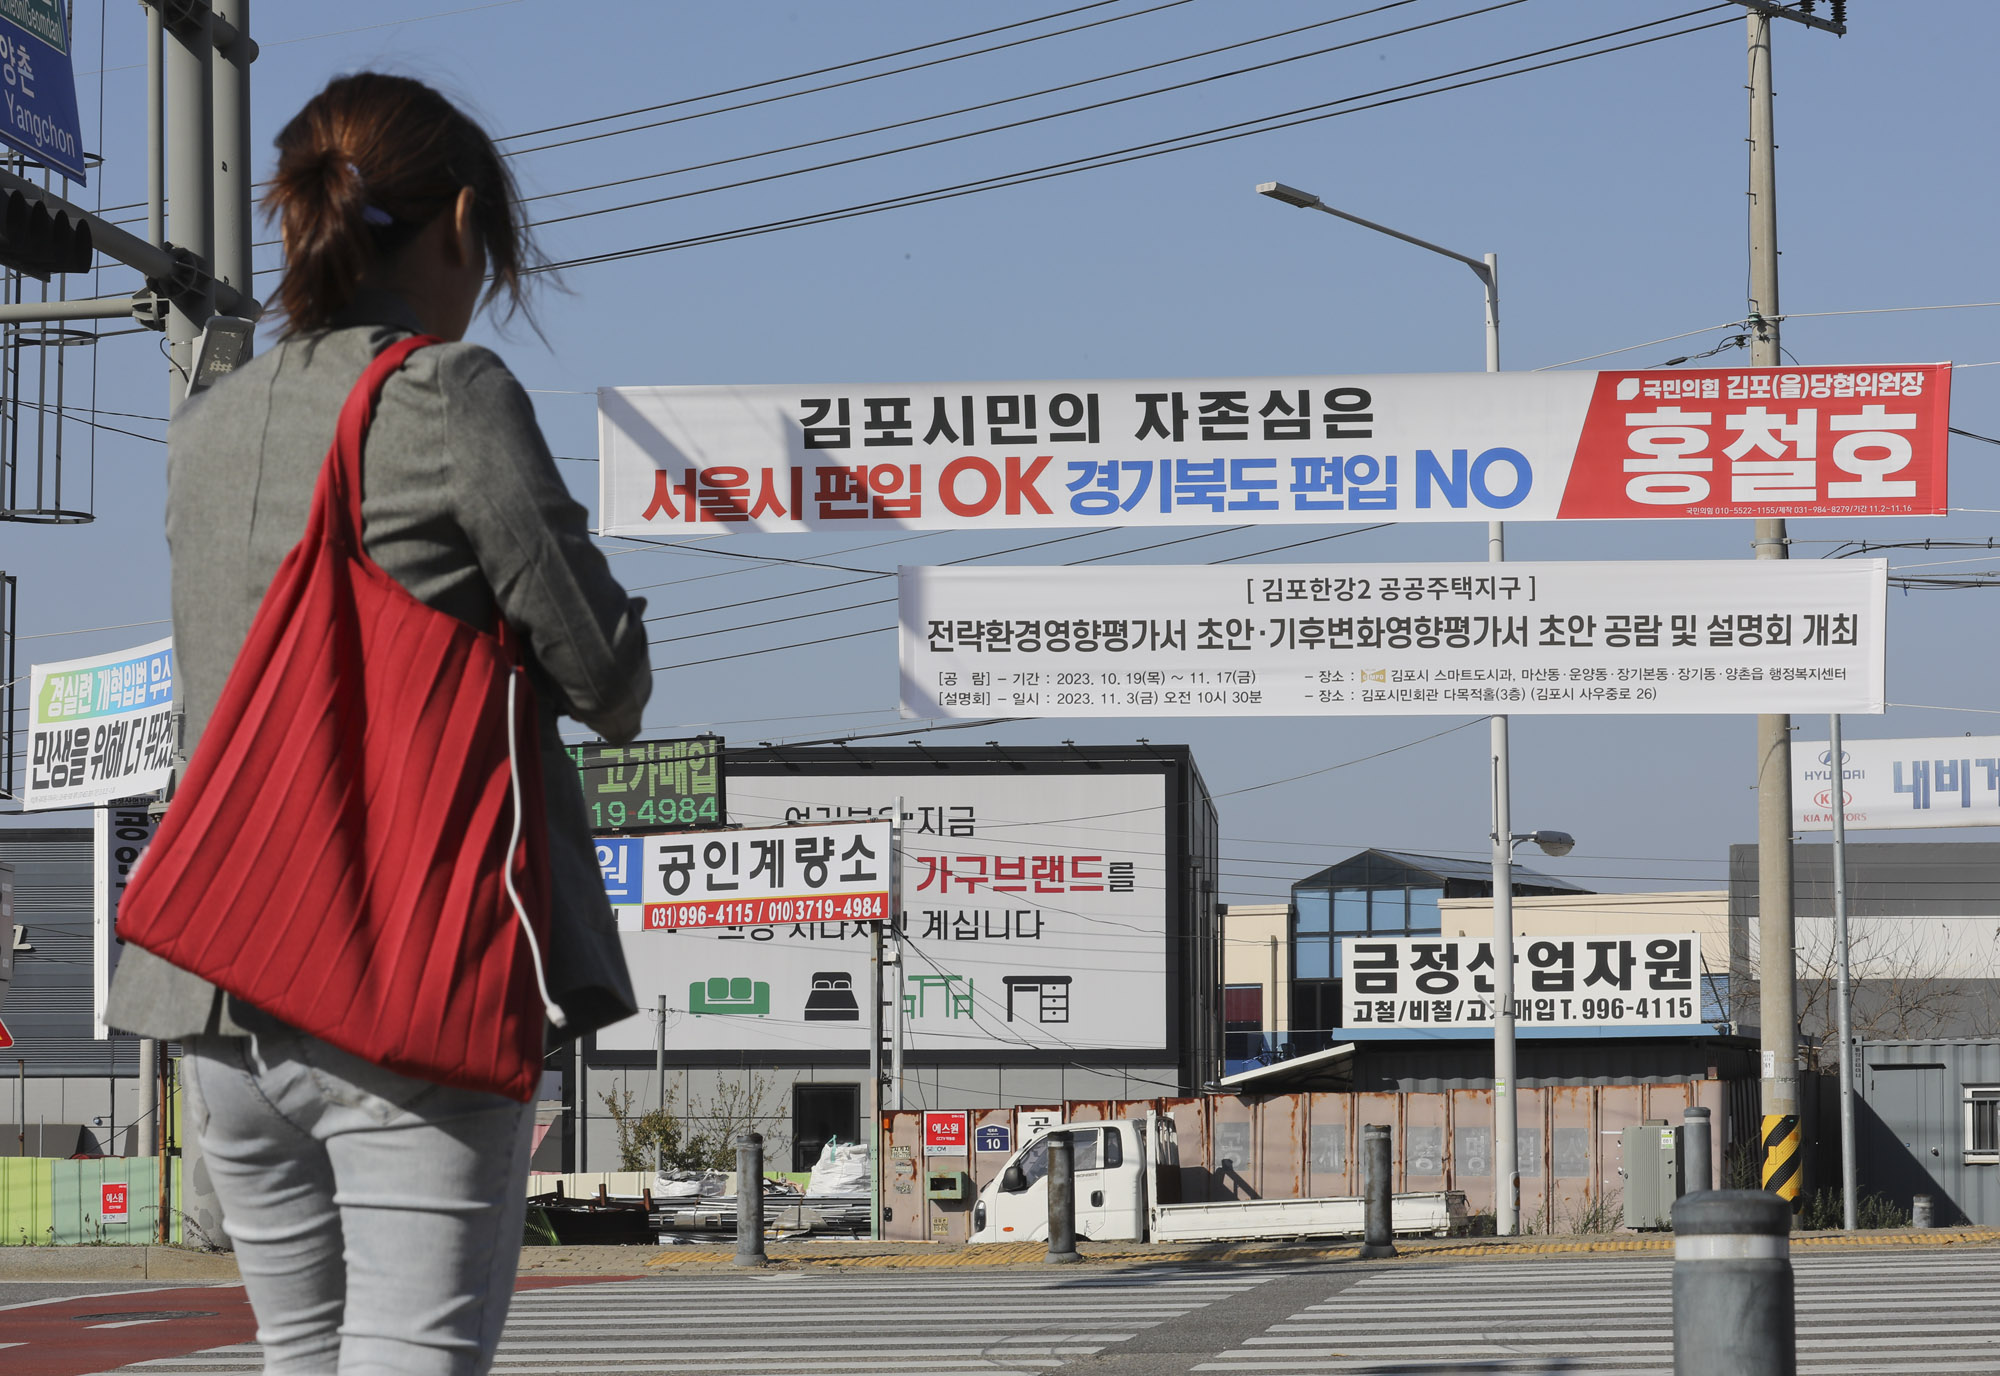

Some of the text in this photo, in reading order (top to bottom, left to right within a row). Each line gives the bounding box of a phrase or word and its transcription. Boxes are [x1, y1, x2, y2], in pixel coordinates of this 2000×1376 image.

[0, 35, 35, 99] 양촌
[4, 89, 76, 158] Yangchon
[1643, 371, 1925, 399] 국민의힘 김포(을)당협위원장
[799, 388, 1374, 449] 김포시민의 자존심은
[1623, 404, 1917, 505] 홍철호
[642, 447, 1533, 522] 서울시 편입 OK 경기북도 편입 NO
[1686, 507, 1714, 515] 국민의힘
[1869, 504, 1912, 512] 11.2~11.16
[1379, 576, 1521, 602] 공공주택지구
[927, 618, 1186, 653] 전략환경영향평가서
[1539, 615, 1597, 647] 초안
[1605, 615, 1662, 648] 공람
[1672, 615, 1697, 646] 및
[1707, 614, 1791, 647] 설명회
[1803, 613, 1858, 647] 개최
[48, 654, 172, 717] 경실련 개혁입법 우수
[1013, 672, 1040, 686] 기간
[1057, 672, 1094, 685] 2023.
[1101, 672, 1121, 685] 10.
[1127, 671, 1165, 685] 19(목)
[1190, 672, 1210, 685] 11.
[1217, 670, 1256, 685] 17(금)
[1319, 670, 1345, 684] 장소
[1391, 669, 1429, 683] 김포시
[1769, 667, 1847, 681] 행정복지센터
[939, 691, 991, 706] [설명회]
[1013, 692, 1039, 706] 일시
[1057, 693, 1094, 705] 2023.
[1102, 693, 1121, 705] 11.
[1126, 691, 1159, 705] 3(금)
[1164, 692, 1191, 705] 오전
[1198, 691, 1226, 704] 10시
[1232, 690, 1263, 704] 30분
[1319, 689, 1345, 703] 장소
[1361, 688, 1438, 703] 김포시민회관
[1444, 687, 1526, 702] 다목적홀(3층)
[1531, 687, 1574, 702] (김포시
[1580, 687, 1631, 701] 사우중로
[1637, 686, 1657, 701] 26)
[32, 727, 90, 791] 민생을
[91, 720, 129, 781] 위해
[123, 716, 147, 777] 더
[597, 739, 718, 798] 고가매입
[1804, 769, 1865, 781] HYUDAI
[917, 804, 977, 838] 지금
[1803, 812, 1867, 823] KIA MTORS
[659, 834, 877, 896] 공인계량소
[916, 853, 1136, 894] 가구브랜드를
[651, 902, 754, 928] 031)996-4115
[768, 896, 882, 922] 010)3719-4984
[921, 909, 1045, 942] 계십니다
[1353, 938, 1693, 995] 금정산업자원
[932, 1122, 959, 1135] 에스원
[986, 1138, 1001, 1150] 10
[106, 1193, 124, 1204] 에스원
